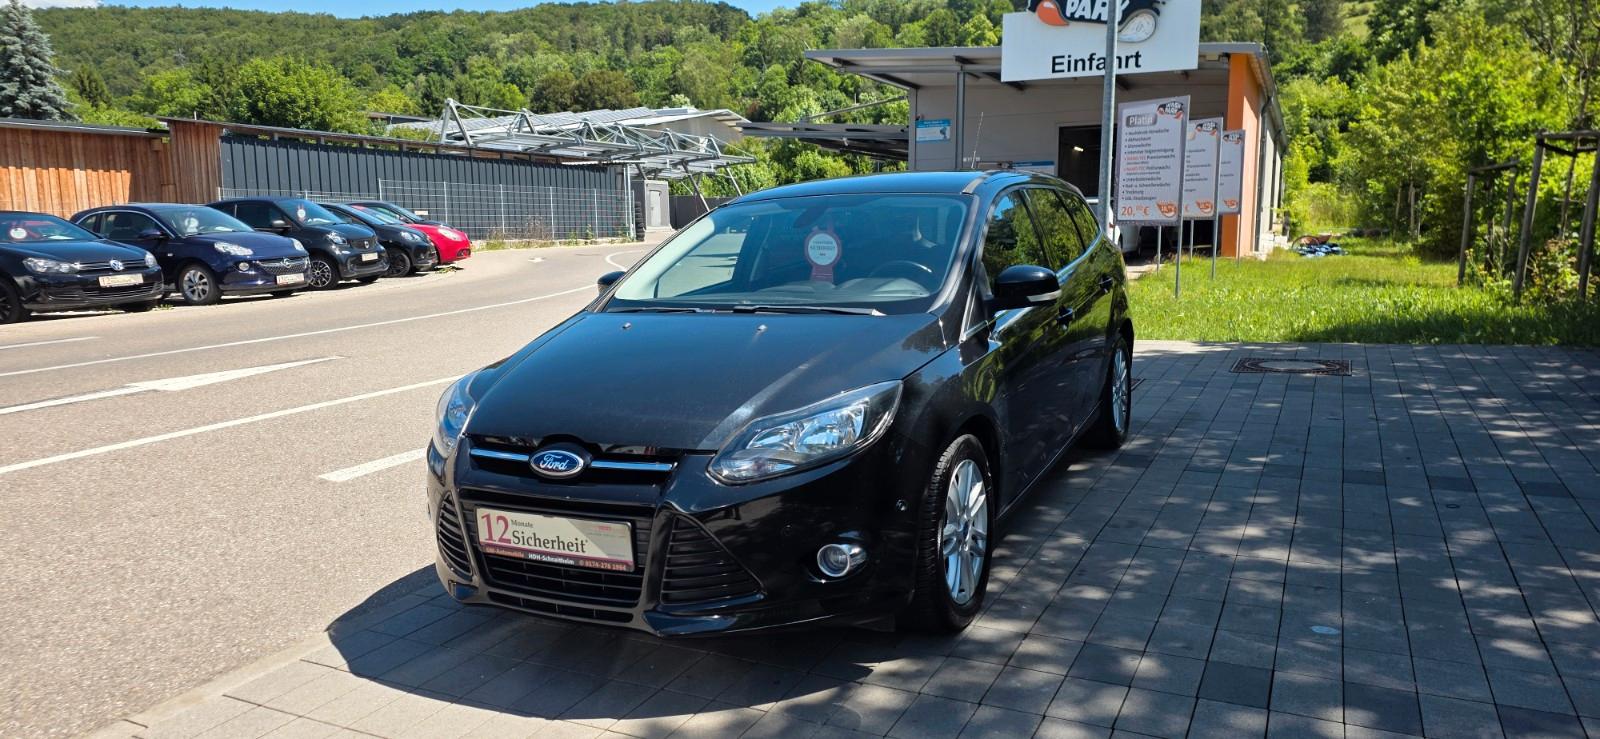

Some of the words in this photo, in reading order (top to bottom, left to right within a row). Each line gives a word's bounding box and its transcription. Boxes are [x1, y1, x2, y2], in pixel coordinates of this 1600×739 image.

[1129, 115, 1153, 126] Platin
[539, 453, 570, 471] Ford
[481, 512, 511, 544] 12
[511, 519, 534, 528] Monate
